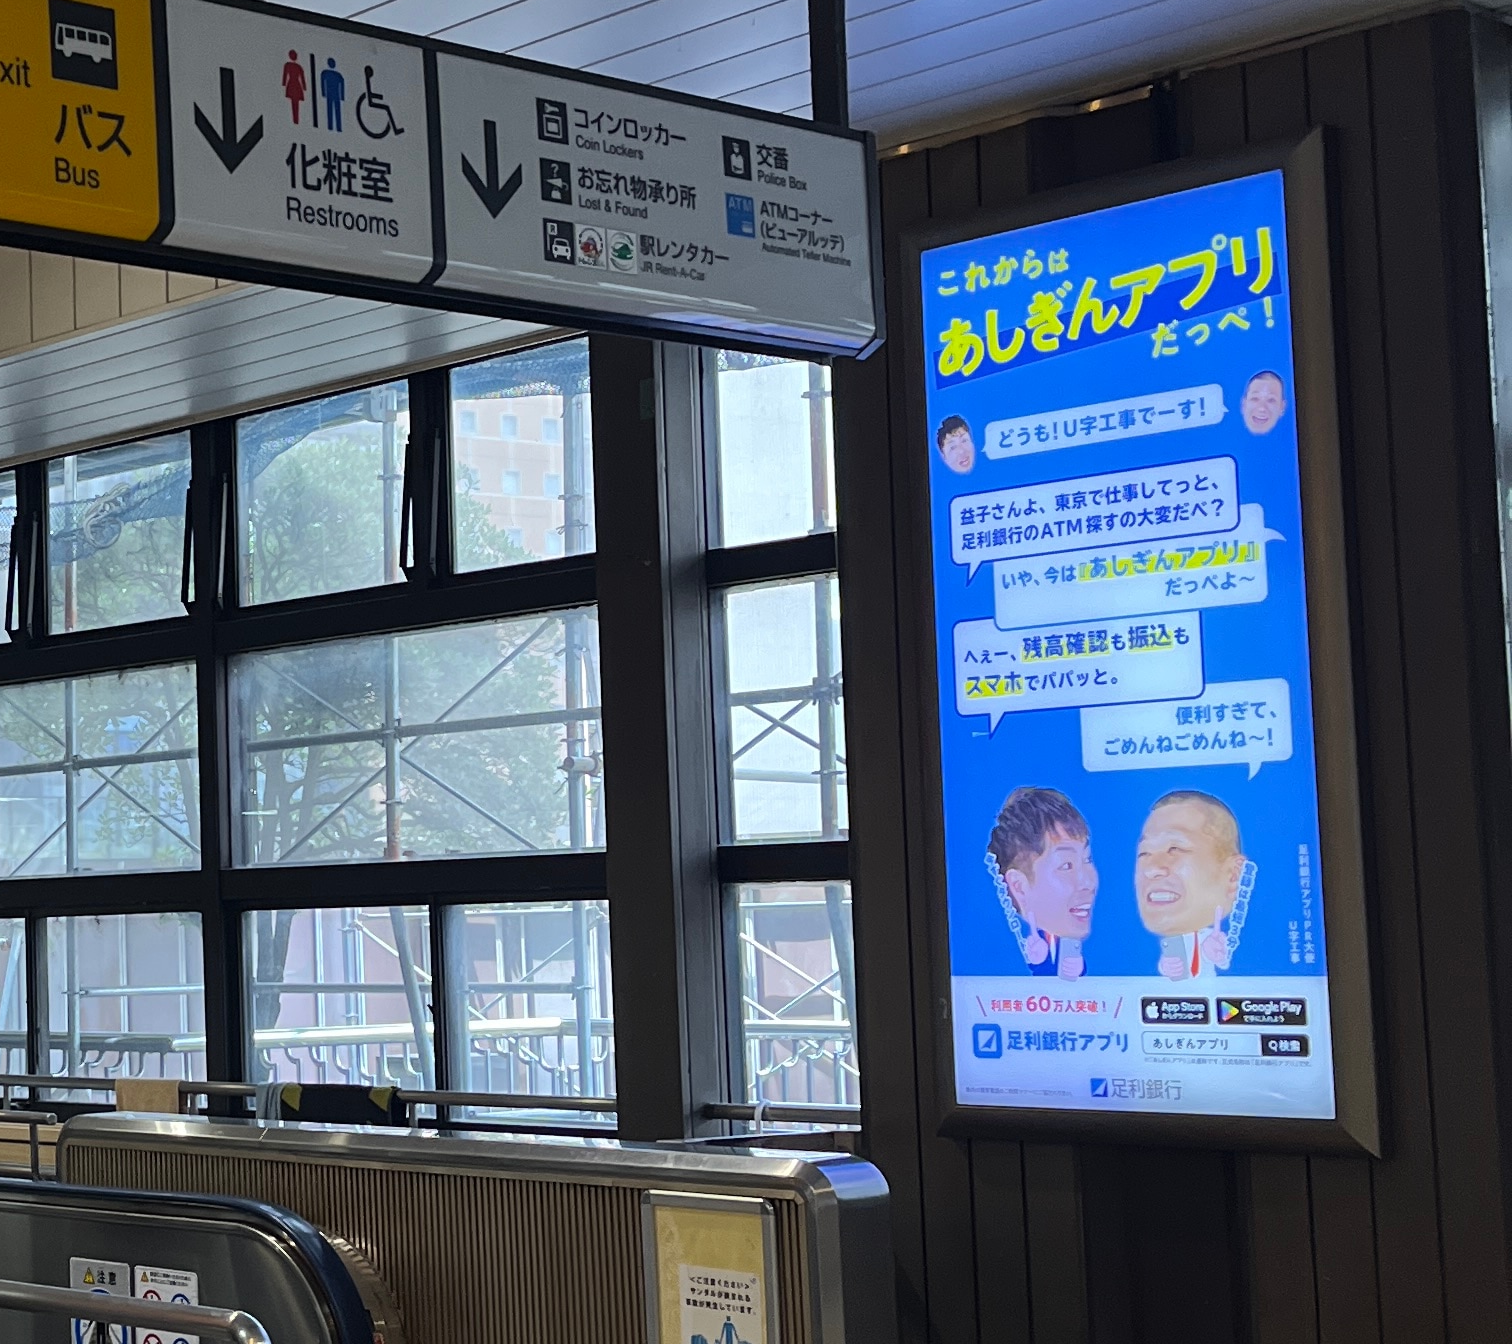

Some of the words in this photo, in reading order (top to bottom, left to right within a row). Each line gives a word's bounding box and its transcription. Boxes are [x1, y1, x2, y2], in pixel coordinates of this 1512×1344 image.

[54, 104, 133, 157] バス
[574, 108, 687, 146] コインロッカー
[575, 135, 600, 152] Coin
[603, 140, 644, 160] Lockers
[756, 144, 789, 171] 交番
[54, 158, 101, 190] Bus
[285, 142, 394, 203] 化粧室
[757, 169, 786, 188] Police
[789, 175, 807, 191] Box
[577, 166, 697, 210] お忘れ物承り所
[286, 196, 399, 238] Restrooms
[579, 195, 602, 212] Lost
[605, 199, 612, 213] &
[615, 201, 648, 219] Found
[728, 196, 753, 213] ATM
[760, 200, 833, 226] ATMコーナー
[640, 234, 729, 266] 駅レンタカー
[640, 260, 653, 274] JR
[938, 248, 1069, 296] これからは
[938, 226, 1274, 377] あしぎんアプリ
[966, 668, 1119, 696] スマホでパパッと。
[1175, 701, 1277, 726] 便利すぎて、
[1161, 1001, 1179, 1013] App
[1181, 1001, 1206, 1012] Store
[1241, 1000, 1279, 1015] Google
[1280, 1001, 1303, 1016] Play
[1007, 1030, 1129, 1053] 足利銀行アプリ
[1153, 1037, 1229, 1051] あしぎんアプリ
[1110, 1078, 1183, 1101] 足利銀行
